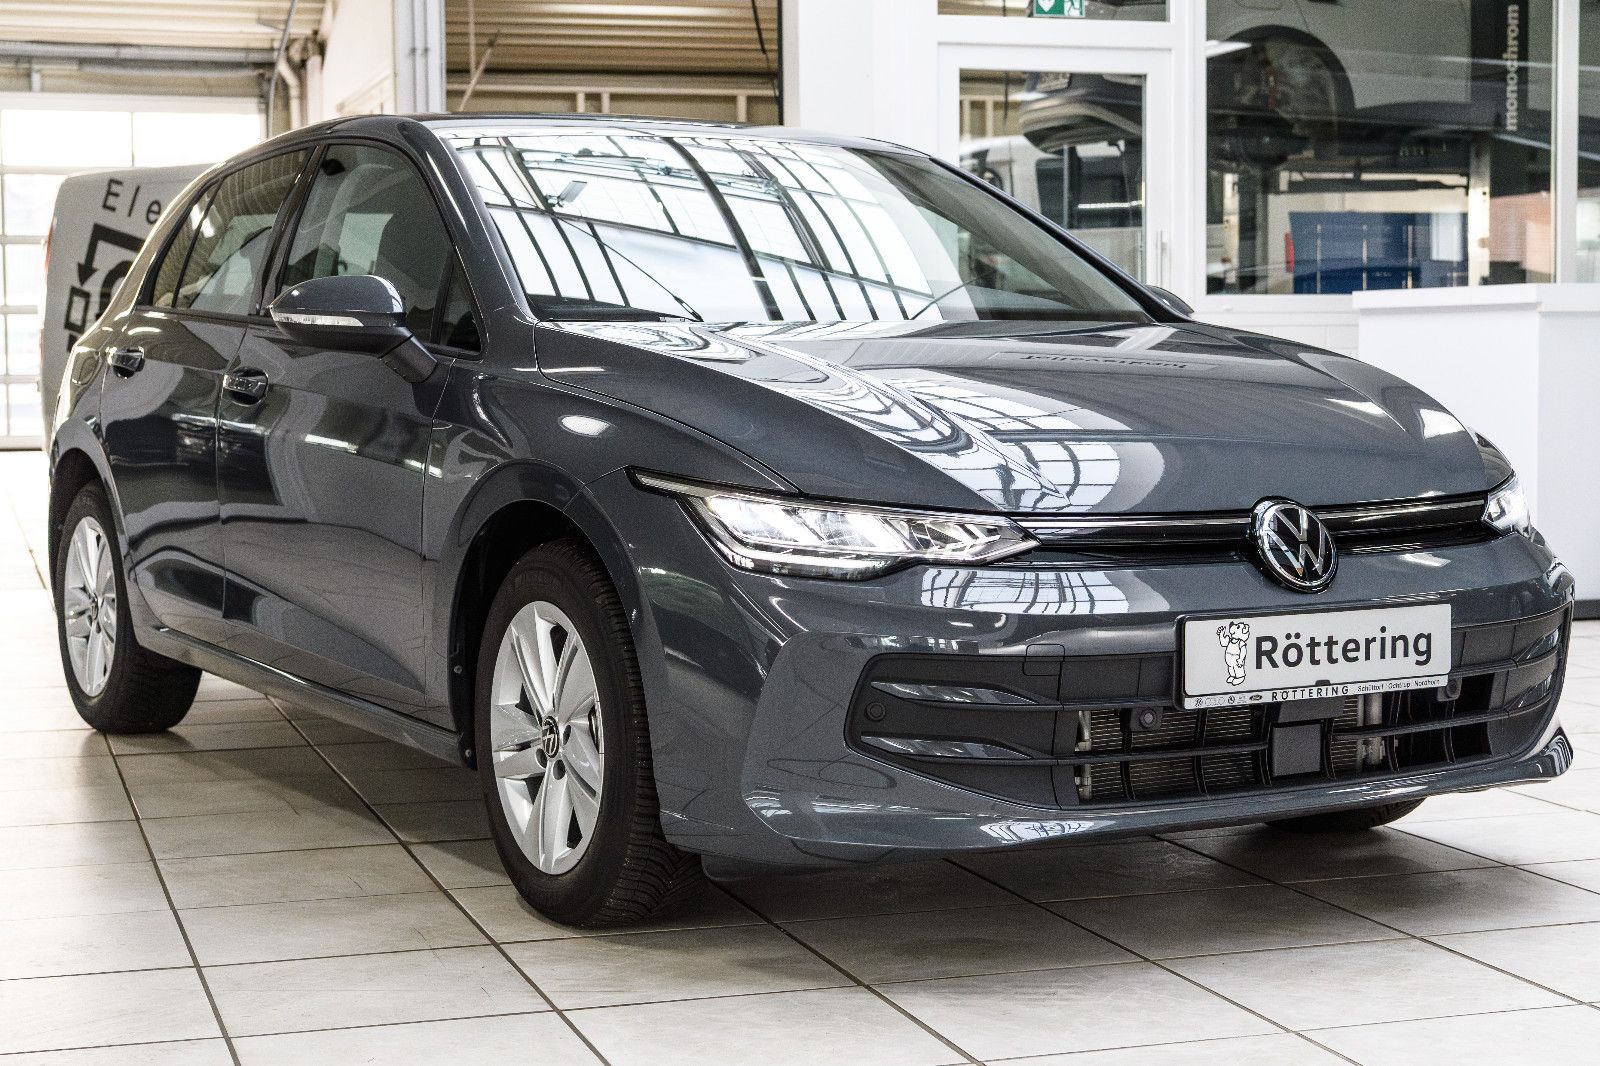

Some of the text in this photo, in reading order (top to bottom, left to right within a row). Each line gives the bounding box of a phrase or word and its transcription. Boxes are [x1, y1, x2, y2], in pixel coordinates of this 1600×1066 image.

[1502, 4, 1519, 131] monochrom
[1255, 625, 1432, 670] Röttering
[1271, 685, 1350, 701] RÖTTERING
